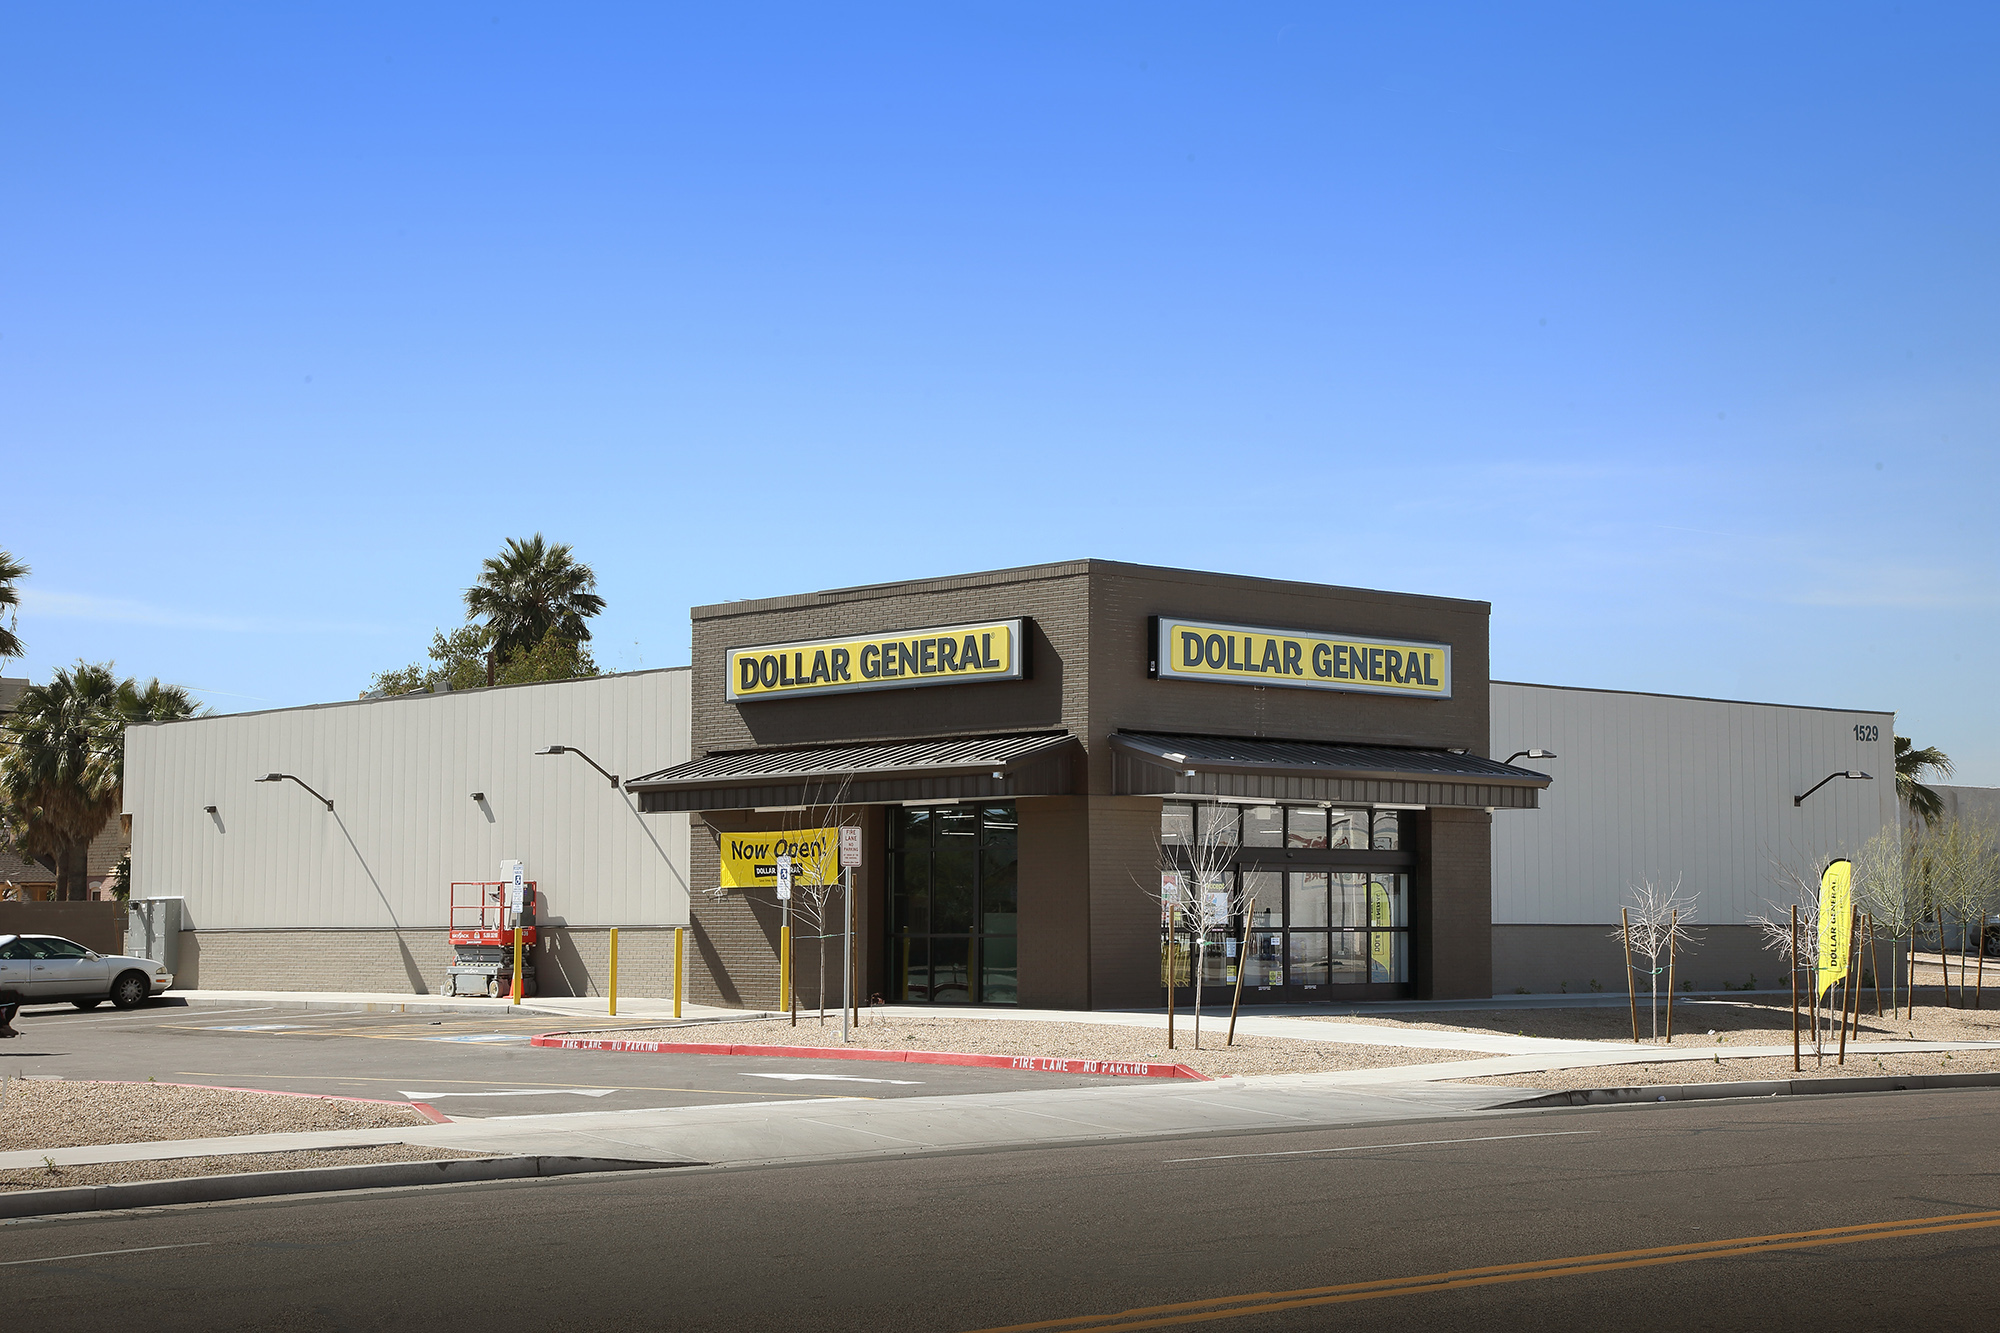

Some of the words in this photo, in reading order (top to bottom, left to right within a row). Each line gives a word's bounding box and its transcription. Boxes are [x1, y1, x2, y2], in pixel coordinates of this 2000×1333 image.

[739, 648, 851, 690] DOLLAR
[859, 633, 999, 679] GENERAL
[1181, 631, 1303, 675] DOLLAR
[1312, 643, 1439, 686] GENERAL
[1853, 724, 1879, 742] 1529
[731, 840, 769, 860] Now
[774, 837, 827, 859] Open!
[756, 867, 776, 875] DOLLAR
[1830, 927, 1838, 967] DOLLAR
[561, 1040, 578, 1048] FIRE
[583, 1041, 602, 1049] LANE
[625, 1042, 658, 1052] PARKING
[1012, 1057, 1035, 1069] FIRE
[1042, 1059, 1069, 1072] LANE
[1083, 1061, 1097, 1073] NO
[1102, 1062, 1148, 1075] PARKING
